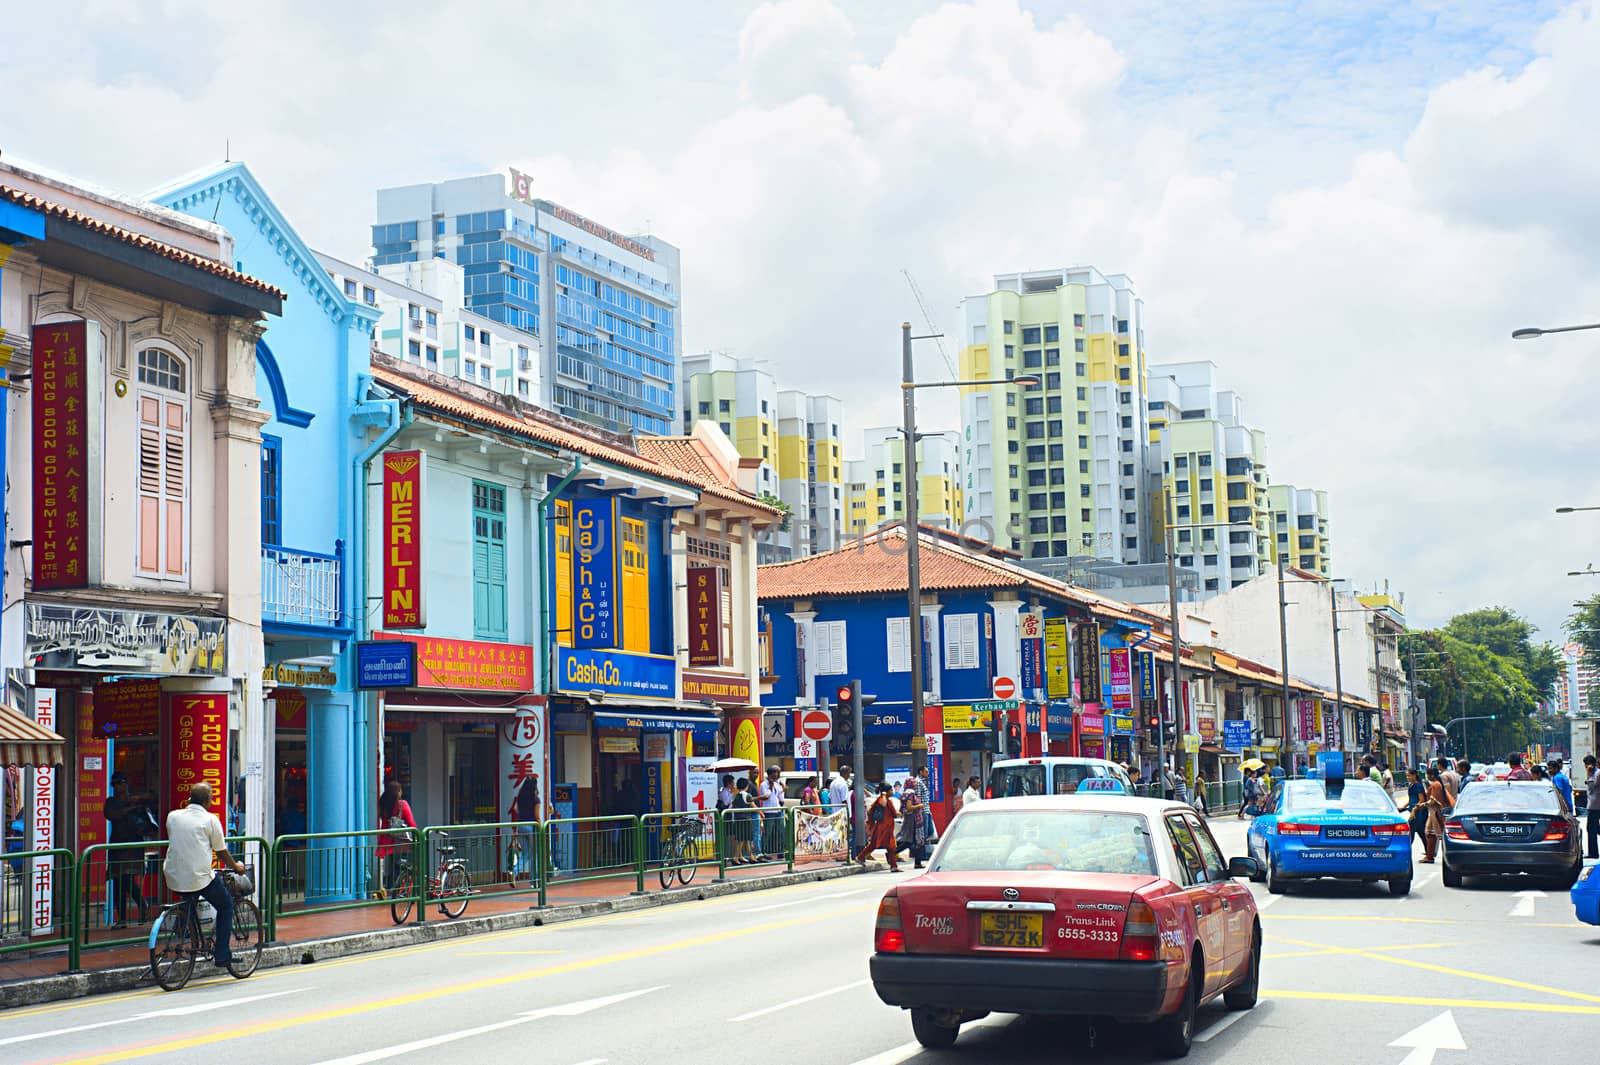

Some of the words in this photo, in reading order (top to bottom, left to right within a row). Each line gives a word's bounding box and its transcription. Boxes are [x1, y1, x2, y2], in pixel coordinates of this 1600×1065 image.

[52, 332, 70, 344] 71
[43, 349, 56, 401] THONG
[44, 407, 57, 449] SOON
[43, 456, 57, 561] GOLDSMITHS
[391, 480, 414, 611] MERLIN
[578, 509, 595, 640] Cash&Co
[387, 613, 402, 625] No.
[404, 612, 417, 623] 75
[697, 575, 710, 652] SATYA
[1023, 614, 1039, 636] 當
[179, 631, 198, 650] PTE
[567, 655, 622, 687] Cash&Co.
[37, 697, 52, 726] THE
[974, 703, 1003, 711] Kerbau
[201, 714, 222, 762] THONG
[511, 715, 536, 741] 75
[1086, 780, 1115, 790] TAXI
[36, 862, 51, 892] PTE
[35, 898, 50, 928] LTD
[1097, 903, 1126, 911] CROWN
[914, 913, 953, 928] TRANS
[932, 926, 954, 935] cab
[995, 913, 1028, 929] SHC
[1065, 915, 1116, 927] Trans-Link
[1057, 927, 1118, 942] 6555-3333
